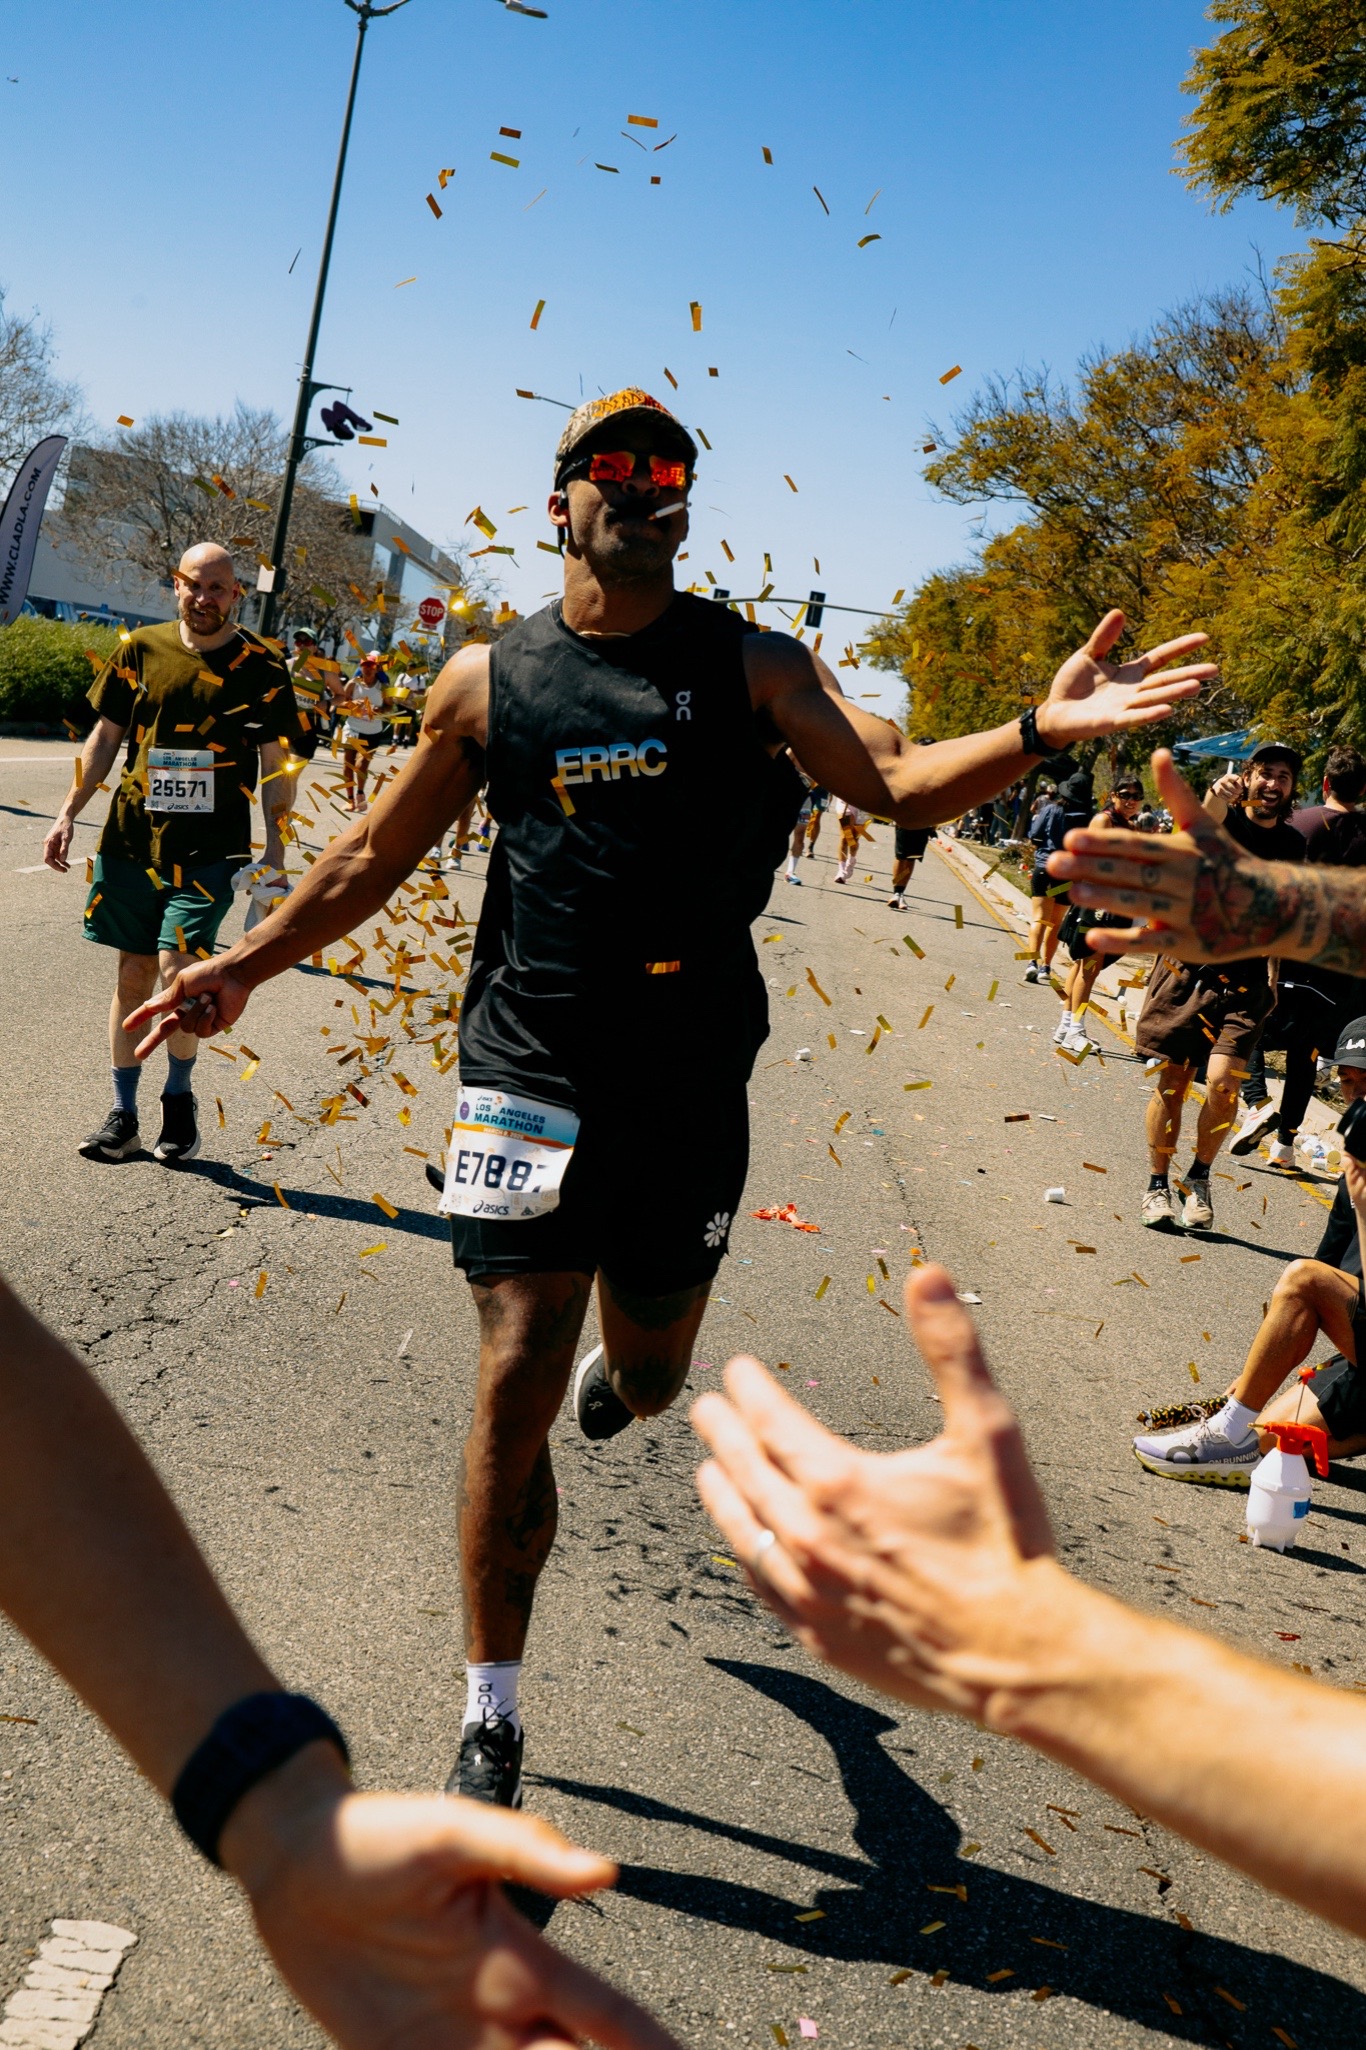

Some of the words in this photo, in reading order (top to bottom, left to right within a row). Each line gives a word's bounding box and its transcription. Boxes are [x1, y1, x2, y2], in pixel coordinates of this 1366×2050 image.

[0, 467, 42, 605] WWW.CLADLA.COM
[420, 605, 444, 617] STOP
[555, 738, 668, 785] ERRC
[152, 779, 207, 798] 25571
[1345, 1038, 1366, 1050] LA
[474, 1113, 544, 1134] MARATHON
[475, 1103, 492, 1112] LOS
[499, 1107, 546, 1124] ANGELES
[455, 1150, 549, 1193] E788
